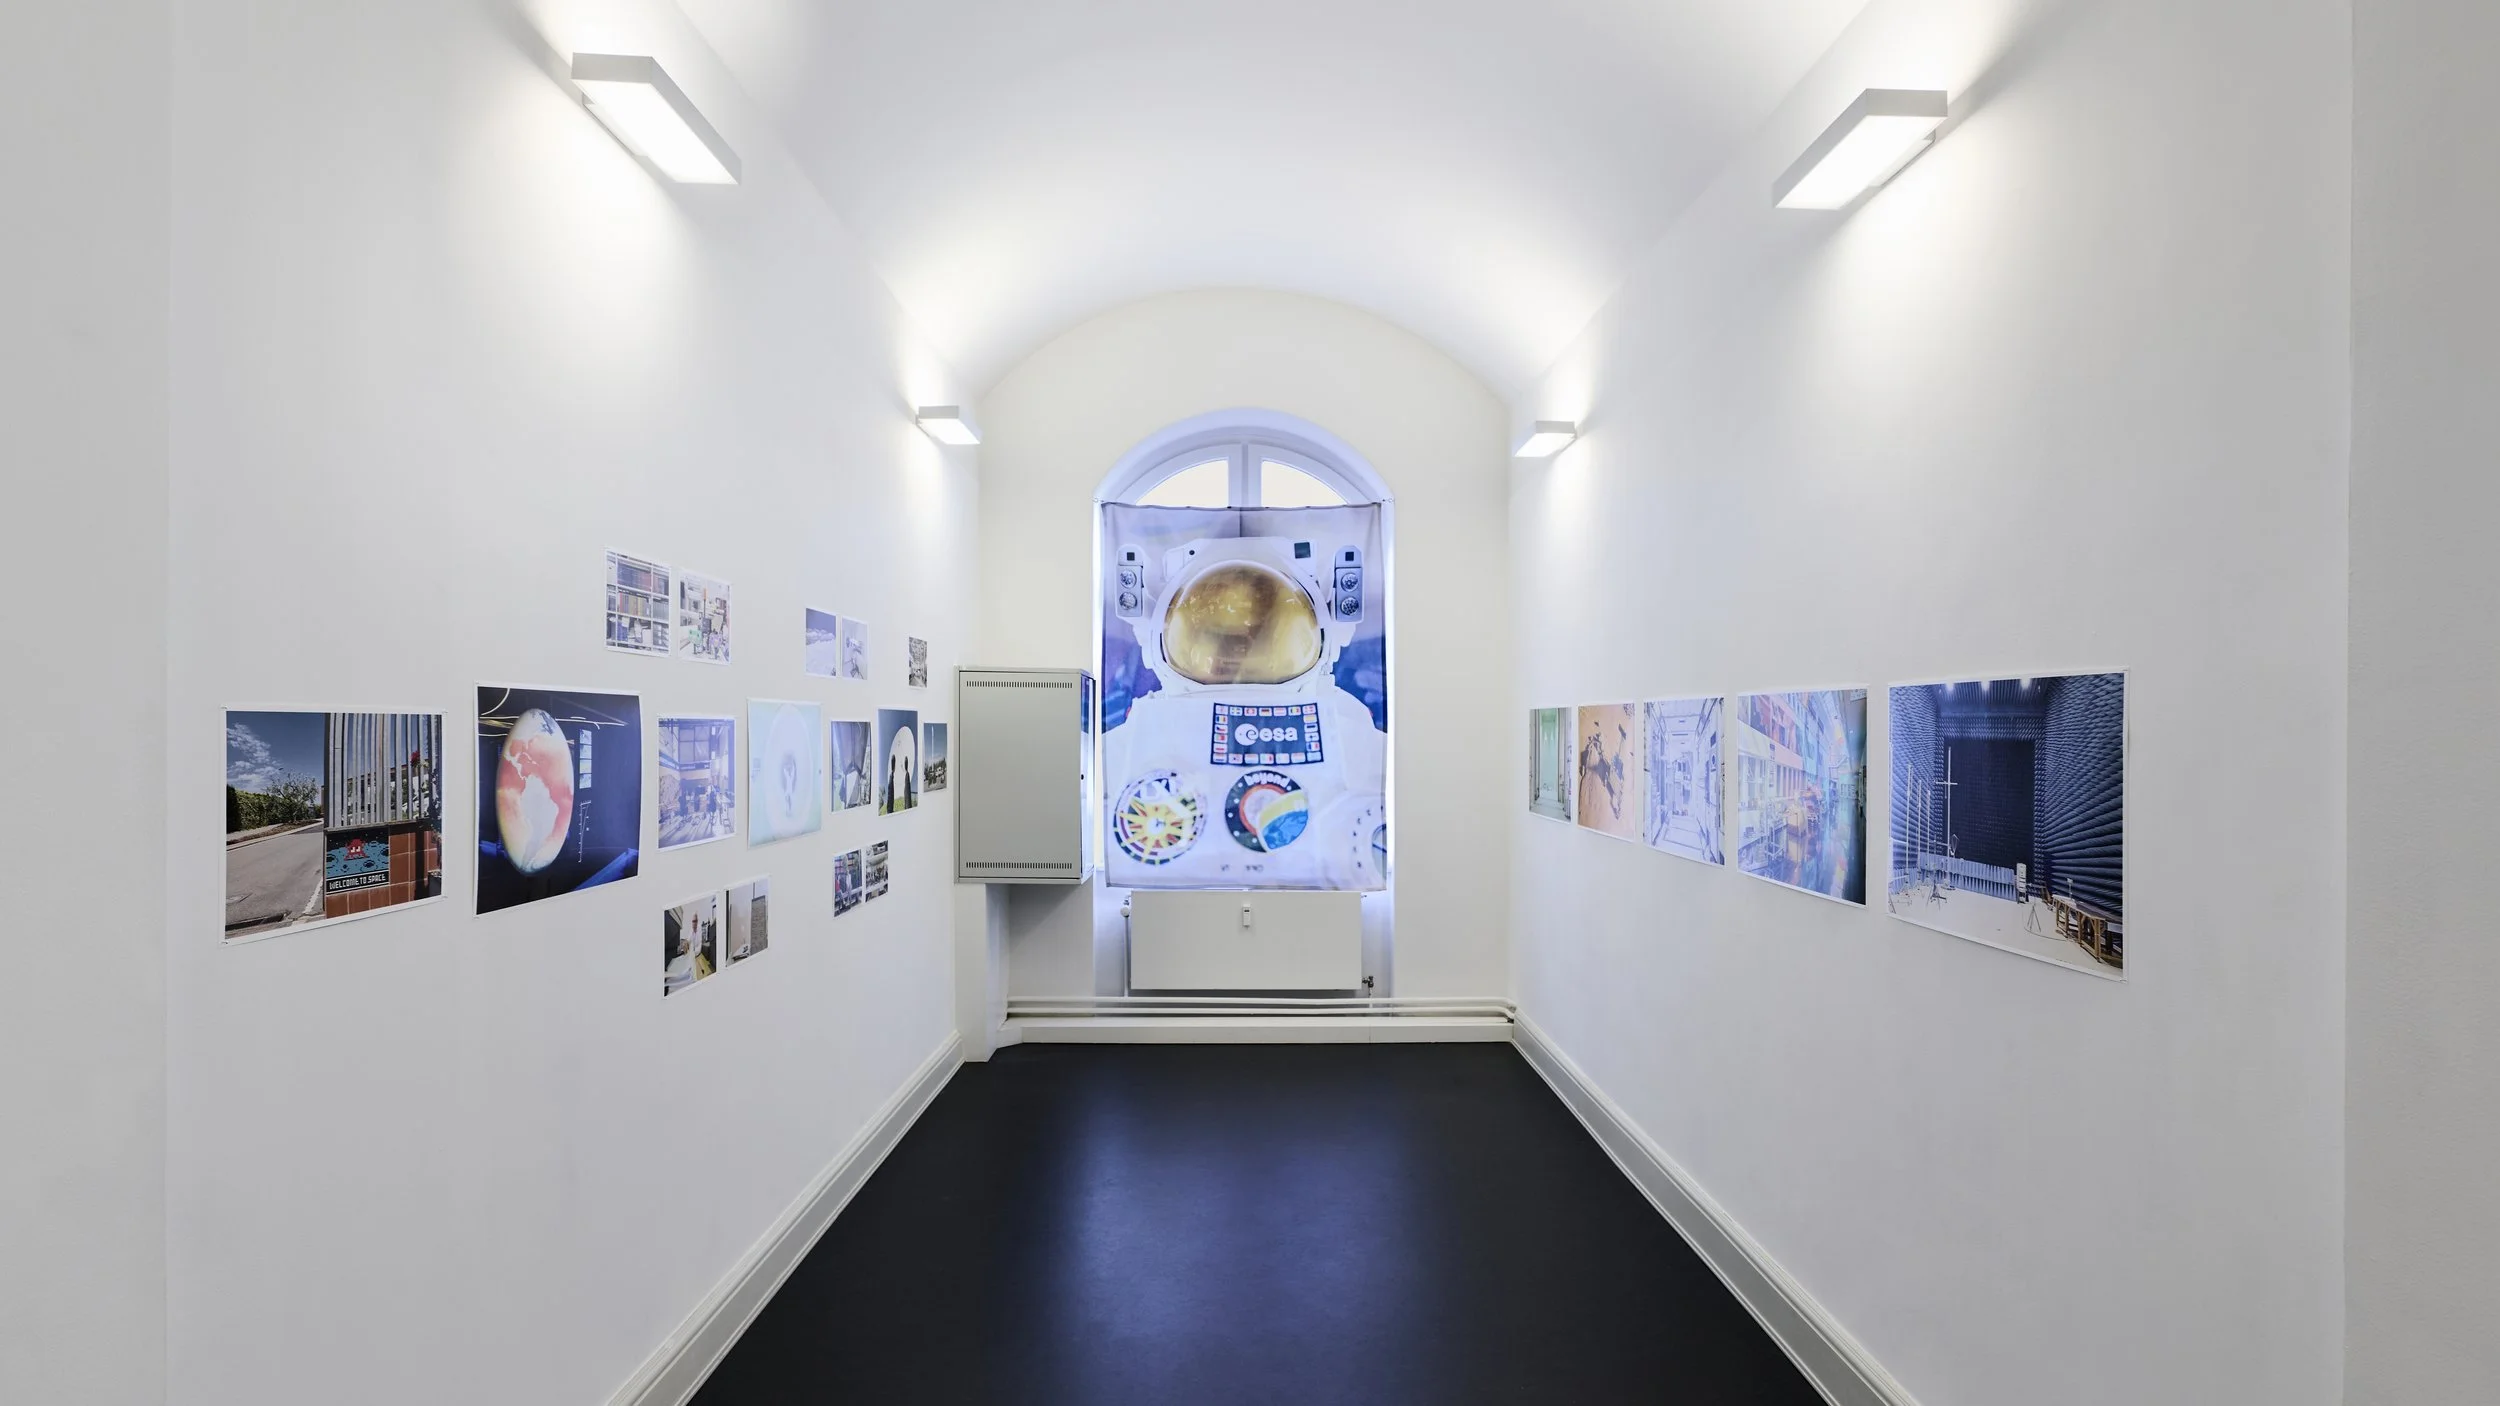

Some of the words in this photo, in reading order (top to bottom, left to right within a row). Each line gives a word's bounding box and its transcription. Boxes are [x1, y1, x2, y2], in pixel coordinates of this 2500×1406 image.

[1244, 772, 1291, 788] beyond
[329, 878, 359, 890] WELCOME
[359, 876, 367, 885] TO
[367, 873, 386, 884] SPACE
